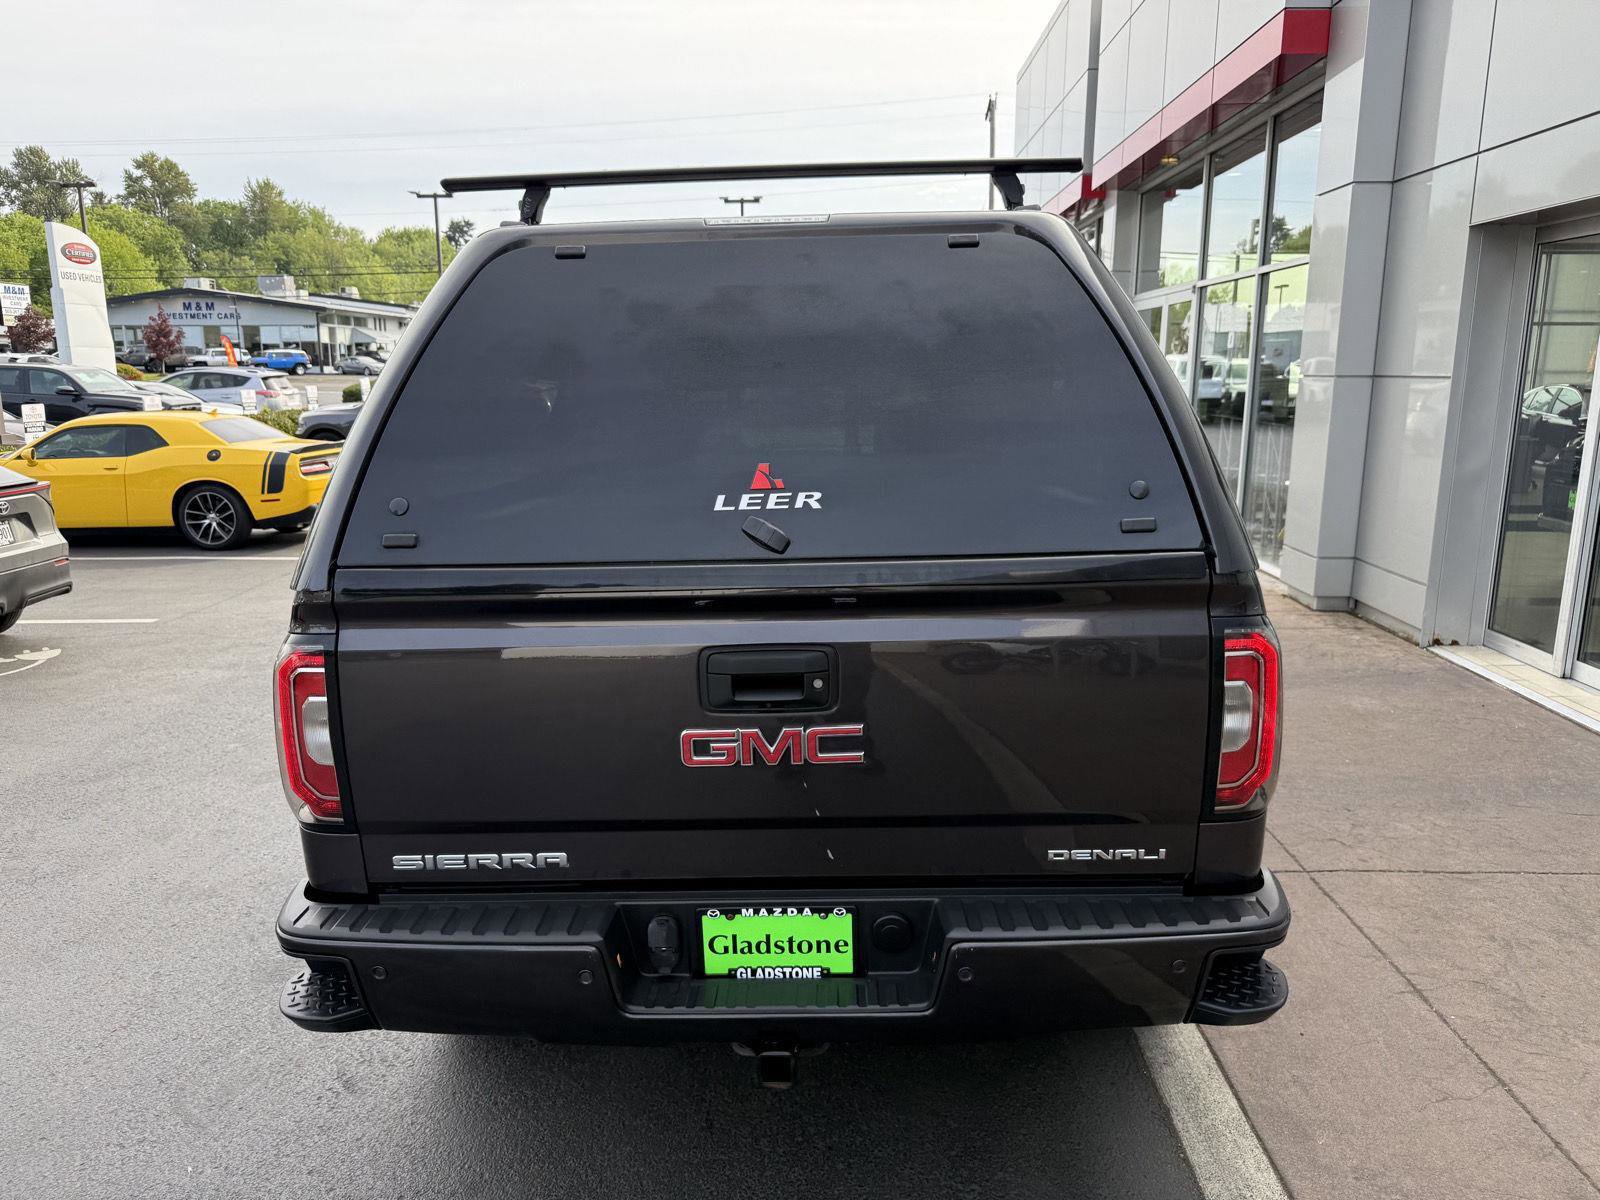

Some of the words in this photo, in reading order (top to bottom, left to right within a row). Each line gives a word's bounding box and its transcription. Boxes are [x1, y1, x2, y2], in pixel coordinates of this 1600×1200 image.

[61, 271, 77, 280] USED
[78, 272, 102, 283] VEHICLES
[4, 286, 26, 295] M&M
[183, 302, 193, 311] M
[206, 302, 215, 311] M
[165, 312, 213, 320] VESTMENT
[713, 491, 823, 512] LEER
[680, 724, 865, 767] GMC
[1047, 848, 1167, 860] DENALI
[392, 852, 570, 870] SIERRA
[741, 907, 813, 918] MAZDA
[708, 934, 849, 955] Gladstone
[736, 967, 822, 979] GLADSTONE
